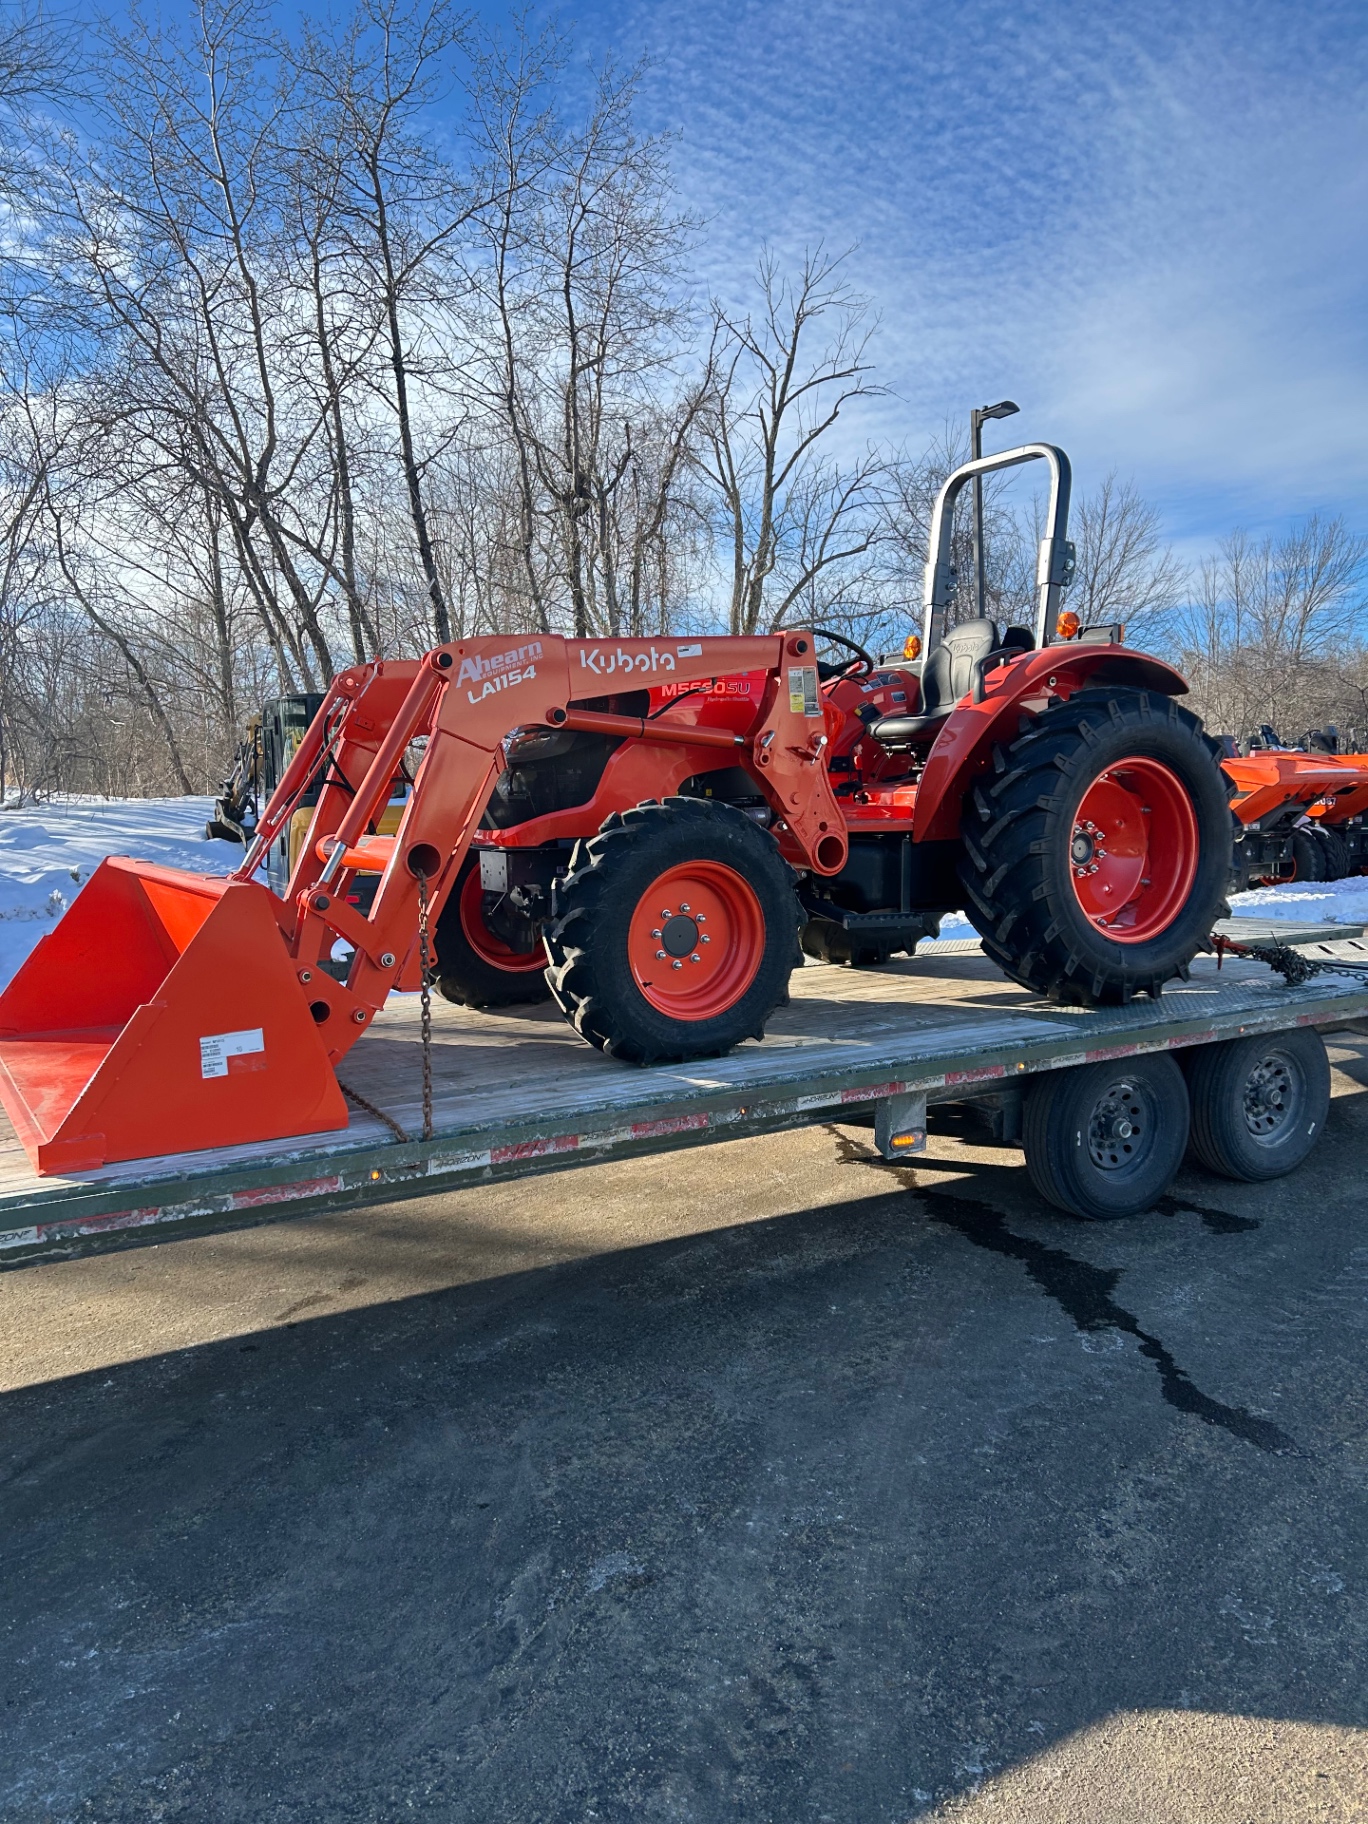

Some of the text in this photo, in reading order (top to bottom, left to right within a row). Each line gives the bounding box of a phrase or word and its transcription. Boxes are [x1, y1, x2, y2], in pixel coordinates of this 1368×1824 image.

[456, 641, 543, 689] Ahearn
[481, 653, 543, 680] EQUIPMENT, INC
[580, 646, 676, 674] Kubota
[467, 665, 537, 704] LA1154
